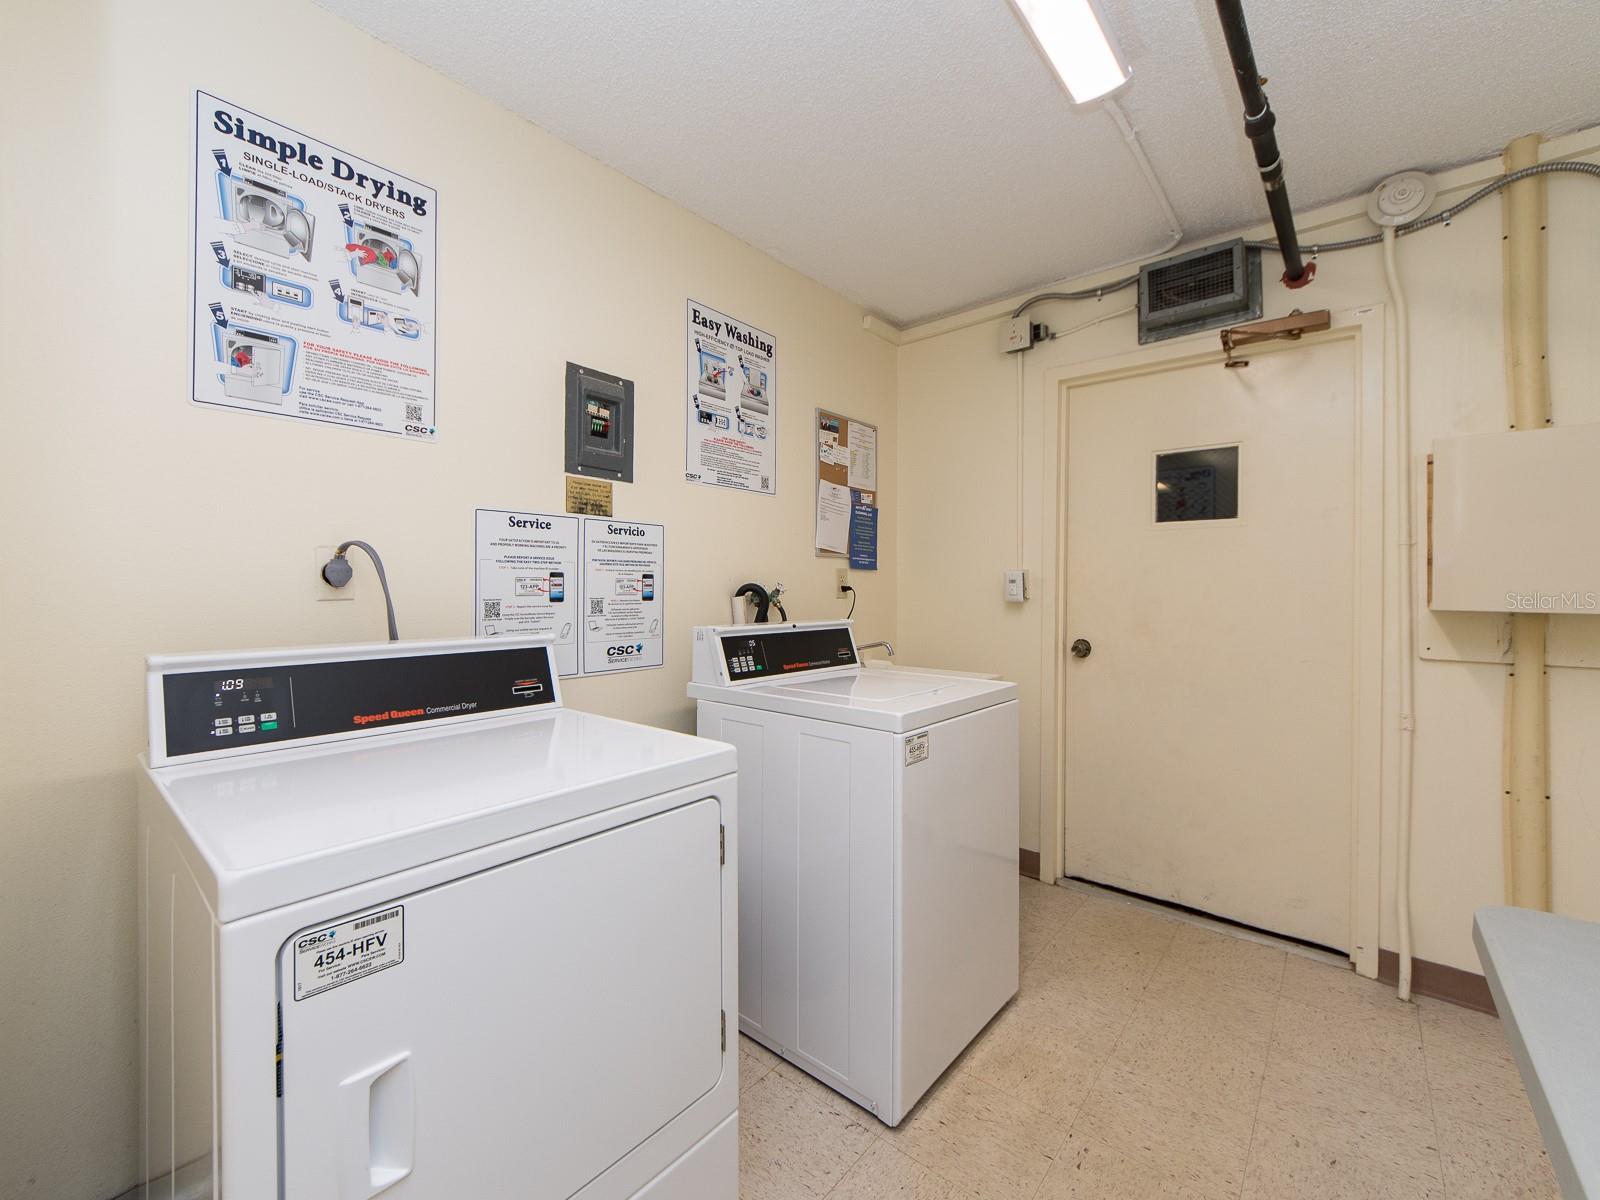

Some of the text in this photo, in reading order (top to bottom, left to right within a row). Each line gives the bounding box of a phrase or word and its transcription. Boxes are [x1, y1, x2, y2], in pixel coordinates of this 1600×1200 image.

[213, 110, 428, 217] Simple Drying
[243, 151, 363, 204] SINGLE-LOAD/STACK
[365, 196, 406, 220] DRYERS
[233, 249, 253, 258] SELECT
[230, 306, 247, 314] START
[692, 308, 721, 337] Easy
[724, 322, 773, 358] Washing
[353, 352, 373, 360] PLEASE
[405, 424, 428, 434] CSC
[508, 516, 552, 530] Service
[607, 524, 645, 537] Servicio
[607, 645, 634, 656] CSC
[353, 702, 477, 724] Speed Queen Commercial Dryer
[298, 934, 327, 948] CSC
[314, 932, 387, 967] 454-HFV
